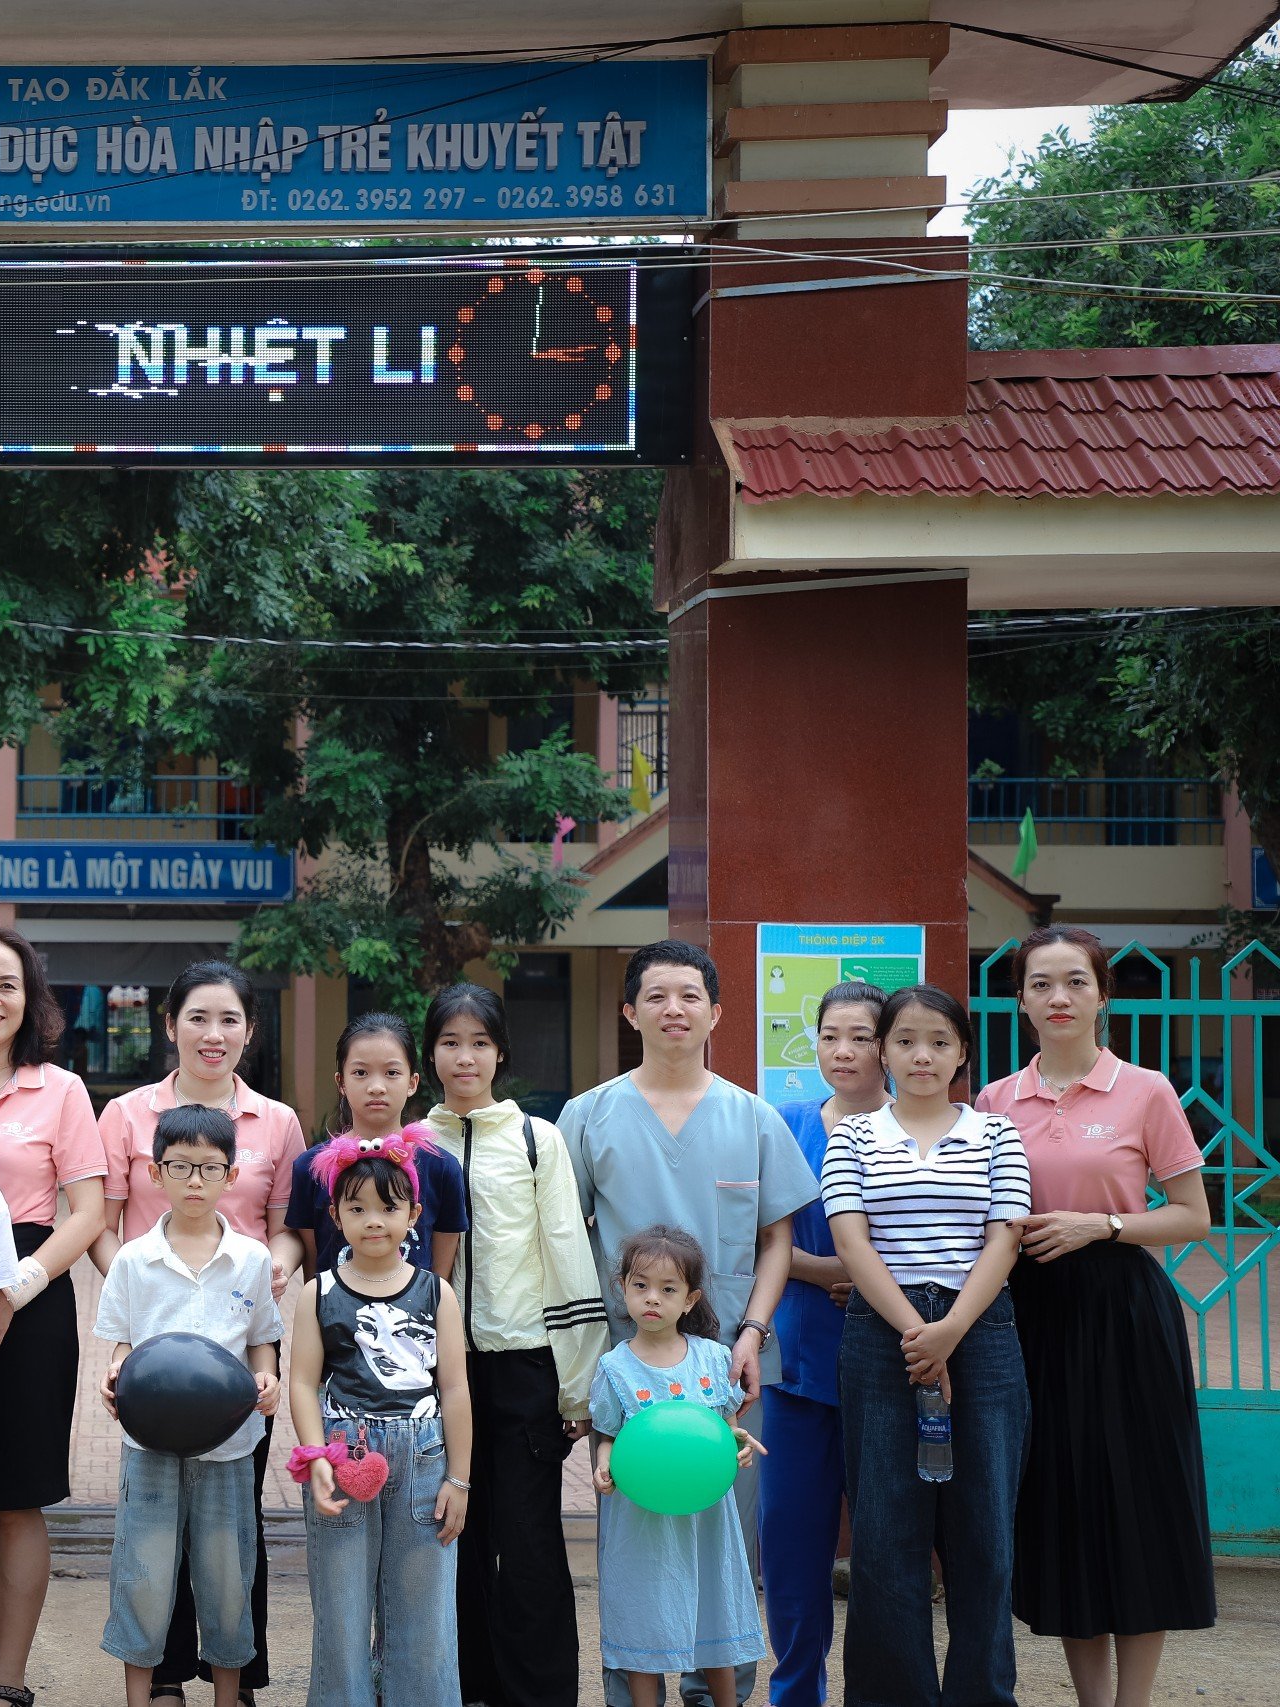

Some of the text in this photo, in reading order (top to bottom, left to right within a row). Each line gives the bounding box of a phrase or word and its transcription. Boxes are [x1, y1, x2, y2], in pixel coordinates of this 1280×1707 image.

[9, 78, 69, 105] TẠO
[86, 66, 151, 102] ĐẮK
[169, 66, 228, 101] LẮK
[97, 116, 179, 174] HÒA
[195, 117, 309, 183] NHẬP
[318, 108, 394, 172] TRẺ
[407, 107, 565, 171] KHUYẾT
[577, 112, 647, 178] TẬT
[242, 189, 277, 211] ĐT:
[424, 187, 466, 210] 297
[635, 183, 676, 207] 631
[373, 325, 437, 384] LI
[46, 850, 80, 889] LÀ
[86, 851, 144, 896] MỘT
[149, 851, 223, 890] NGÀY
[230, 859, 274, 891] VUI
[799, 933, 838, 946] THÔNG
[871, 935, 885, 946] 5K
